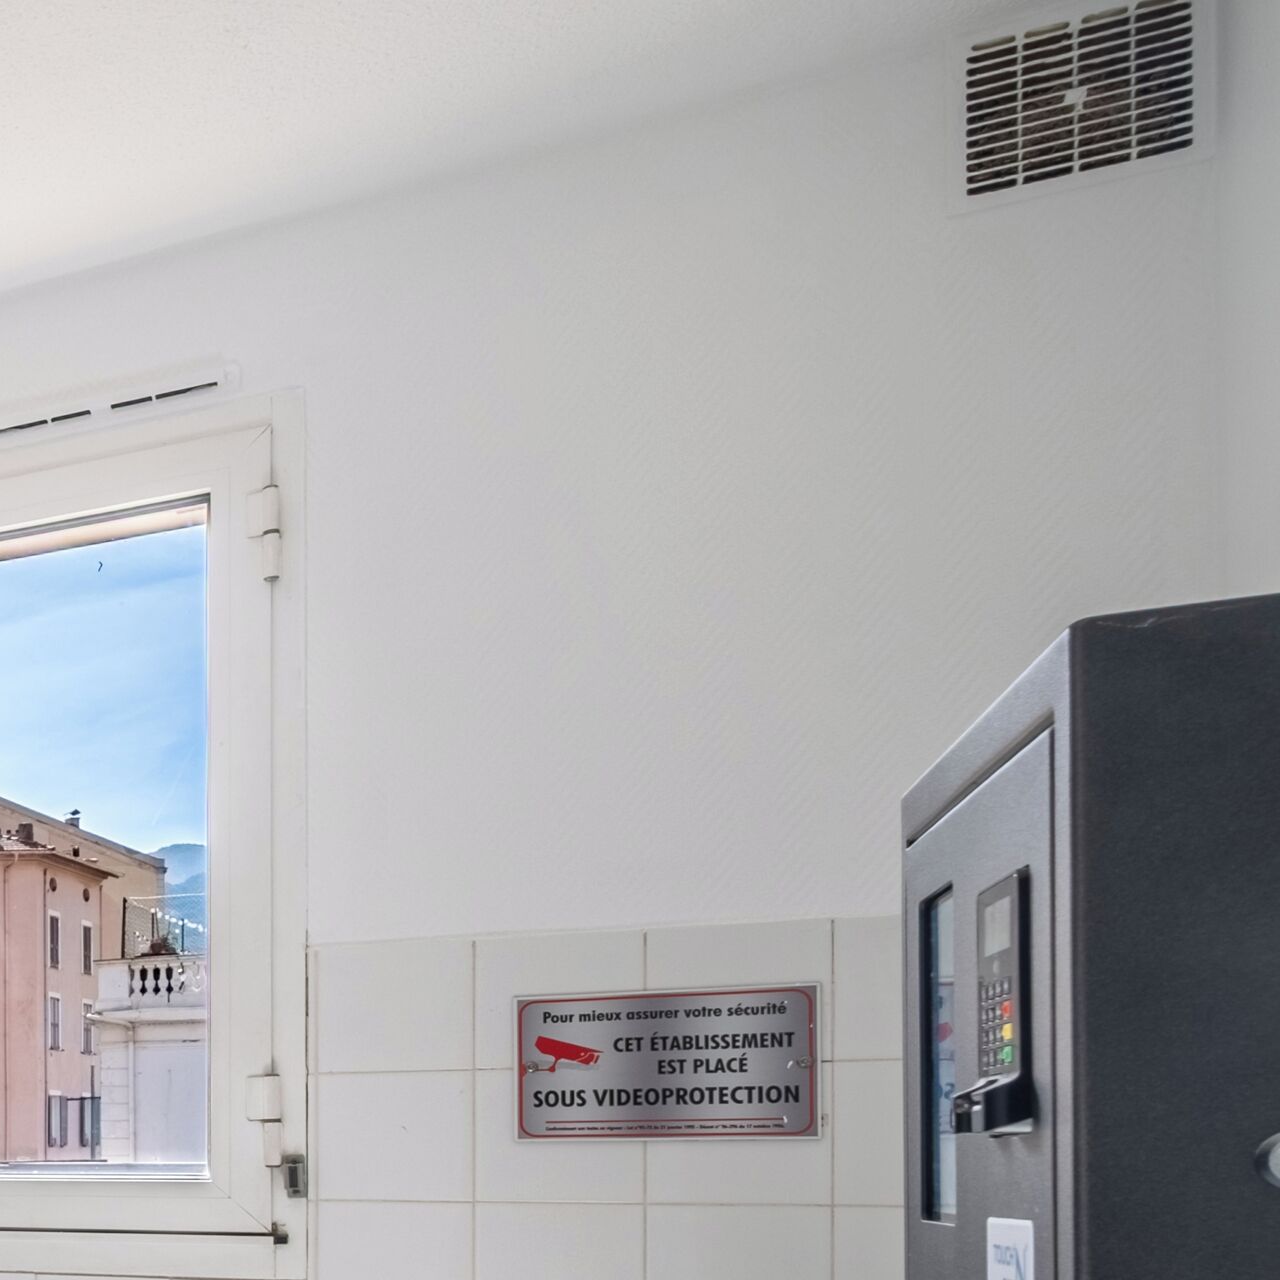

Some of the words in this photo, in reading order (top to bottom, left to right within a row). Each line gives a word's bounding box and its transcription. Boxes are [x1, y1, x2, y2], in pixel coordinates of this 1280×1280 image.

[543, 1011, 574, 1024] Pour
[579, 1009, 622, 1022] mieux
[626, 1008, 679, 1020] assurer
[684, 1006, 722, 1018] votre
[727, 1001, 787, 1016] sécurité
[613, 1036, 645, 1053] CET
[650, 1031, 795, 1052] ÉTABLISSEMENT
[657, 1059, 687, 1075] EST
[693, 1053, 748, 1074] PLACÉ
[533, 1090, 586, 1108] SOUS
[593, 1085, 800, 1107] VIDEOPROTECTION
